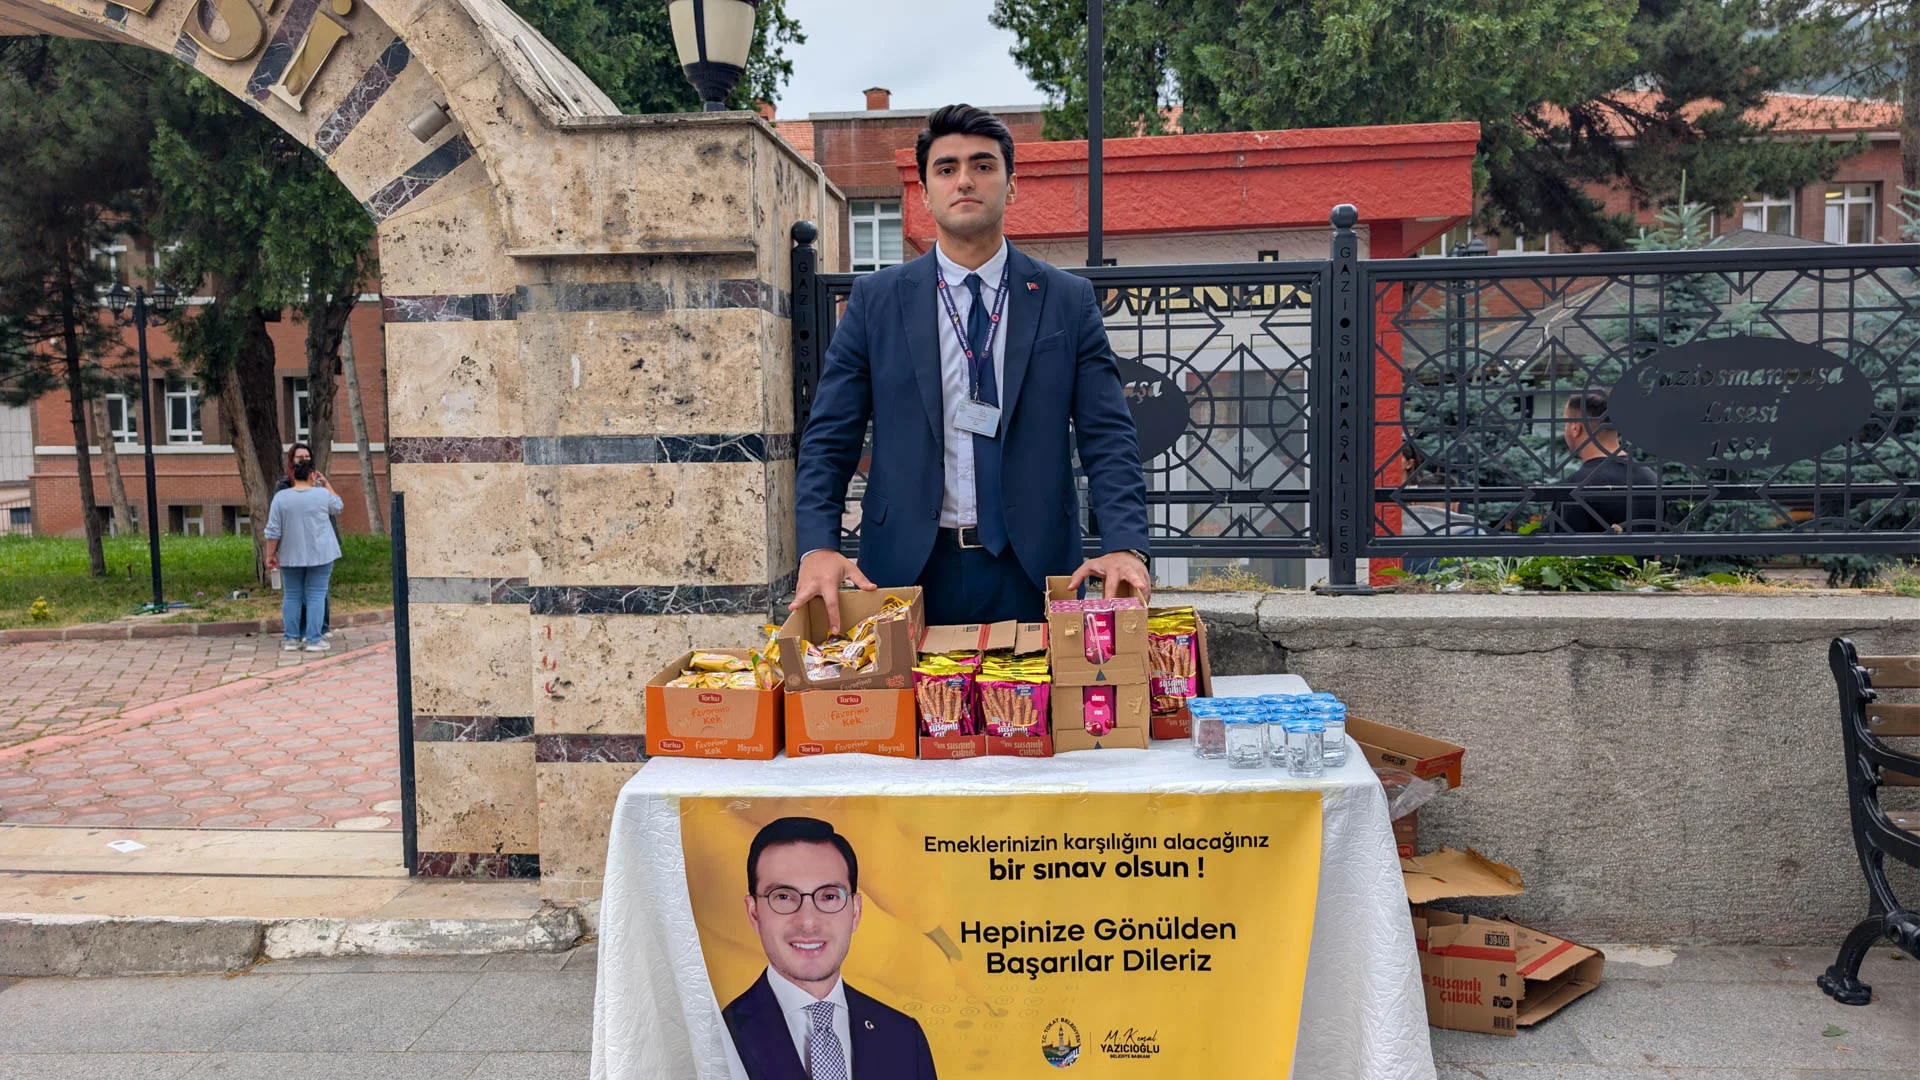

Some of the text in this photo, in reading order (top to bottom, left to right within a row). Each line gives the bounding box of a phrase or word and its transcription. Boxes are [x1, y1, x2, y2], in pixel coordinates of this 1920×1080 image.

[1637, 364, 1844, 396] Gaziosmanpaşa
[1700, 398, 1781, 424] Lisesi
[1706, 436, 1772, 461] 1884
[842, 717, 862, 727] Kek
[662, 741, 682, 749] Torku
[800, 745, 820, 753] Torku
[924, 831, 1269, 855] Emeklerinizin karşılığını alacağınız
[989, 857, 1026, 881] bir
[1033, 861, 1107, 880] sınav
[1114, 855, 1189, 878] olsun
[960, 916, 1236, 949] Hepinize Gönülden
[986, 947, 1212, 980] Başarılar Dileriz
[1432, 976, 1482, 993] susamlı
[1439, 991, 1484, 1006] çubuk
[1043, 1017, 1060, 1034] TOKAT
[1100, 1042, 1160, 1054] YAZICIOĞLU
